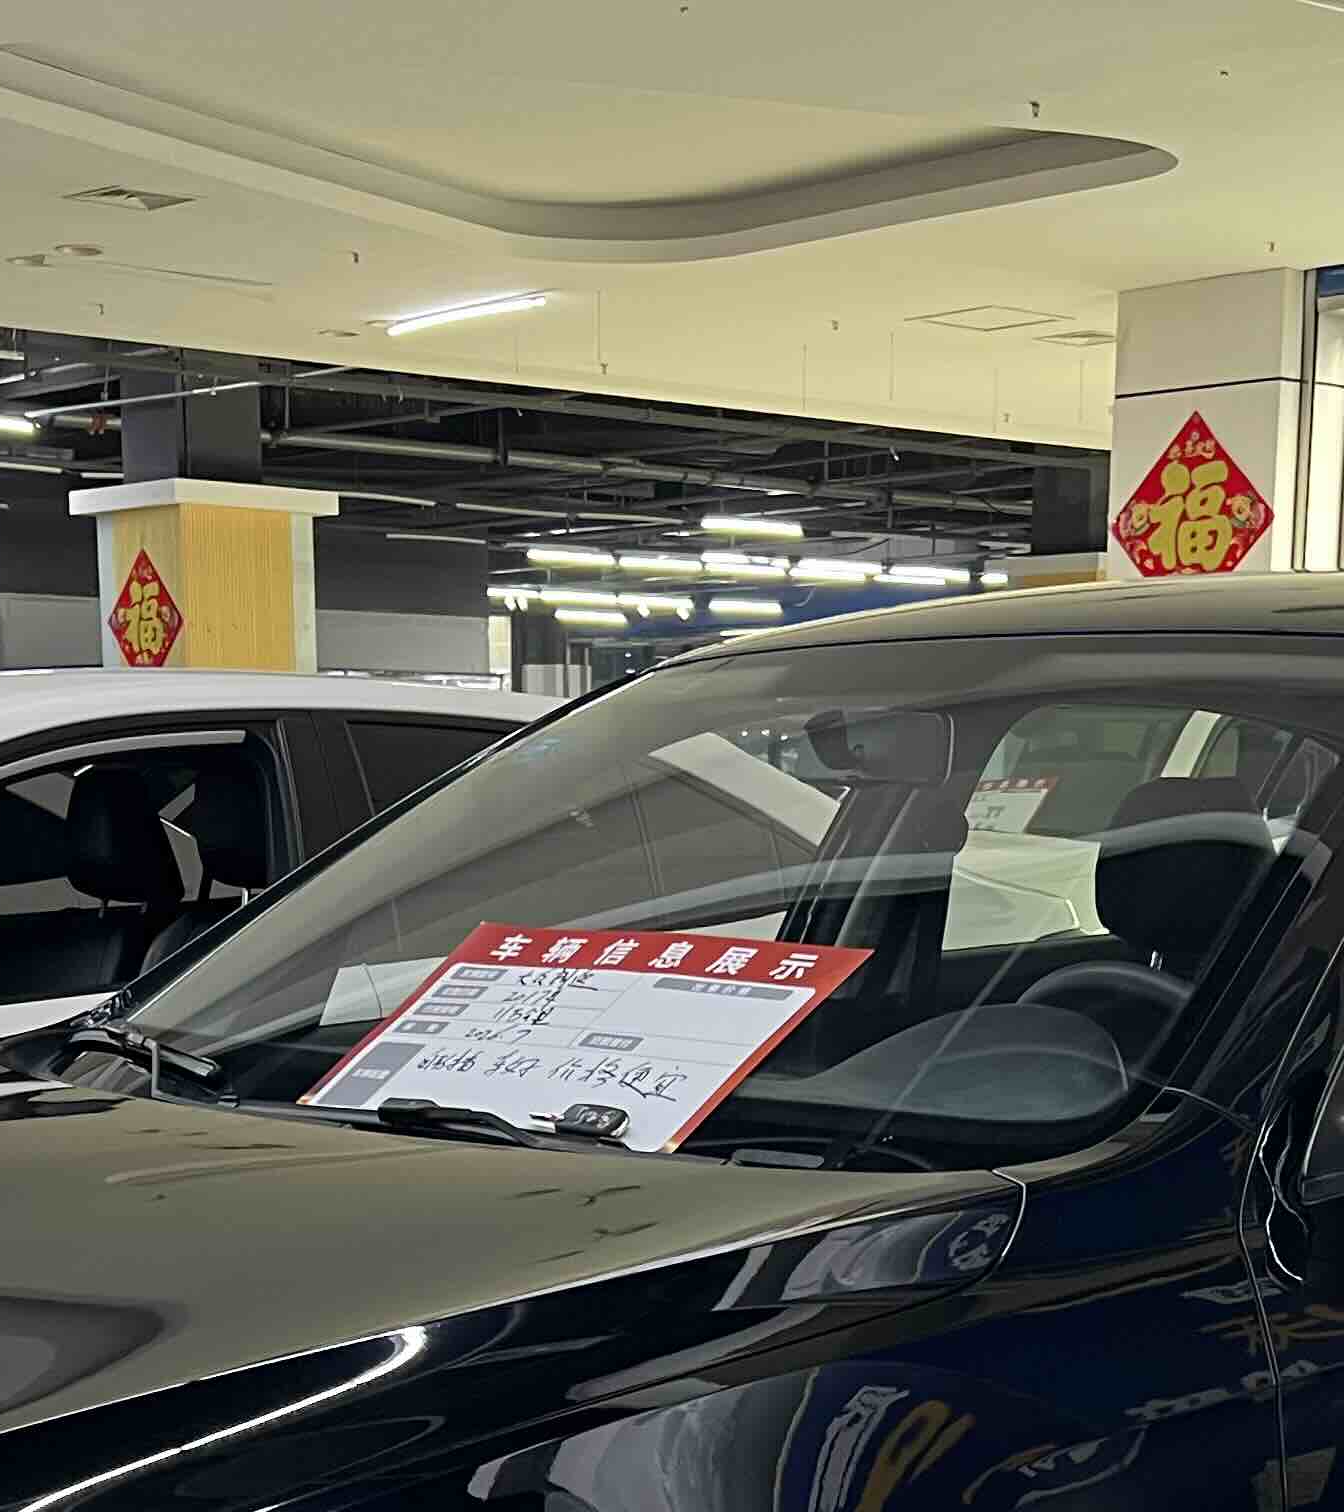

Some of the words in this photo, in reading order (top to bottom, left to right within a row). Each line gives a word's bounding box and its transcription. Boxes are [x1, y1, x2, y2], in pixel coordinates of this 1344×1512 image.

[489, 933, 819, 980] 车辆信息展示
